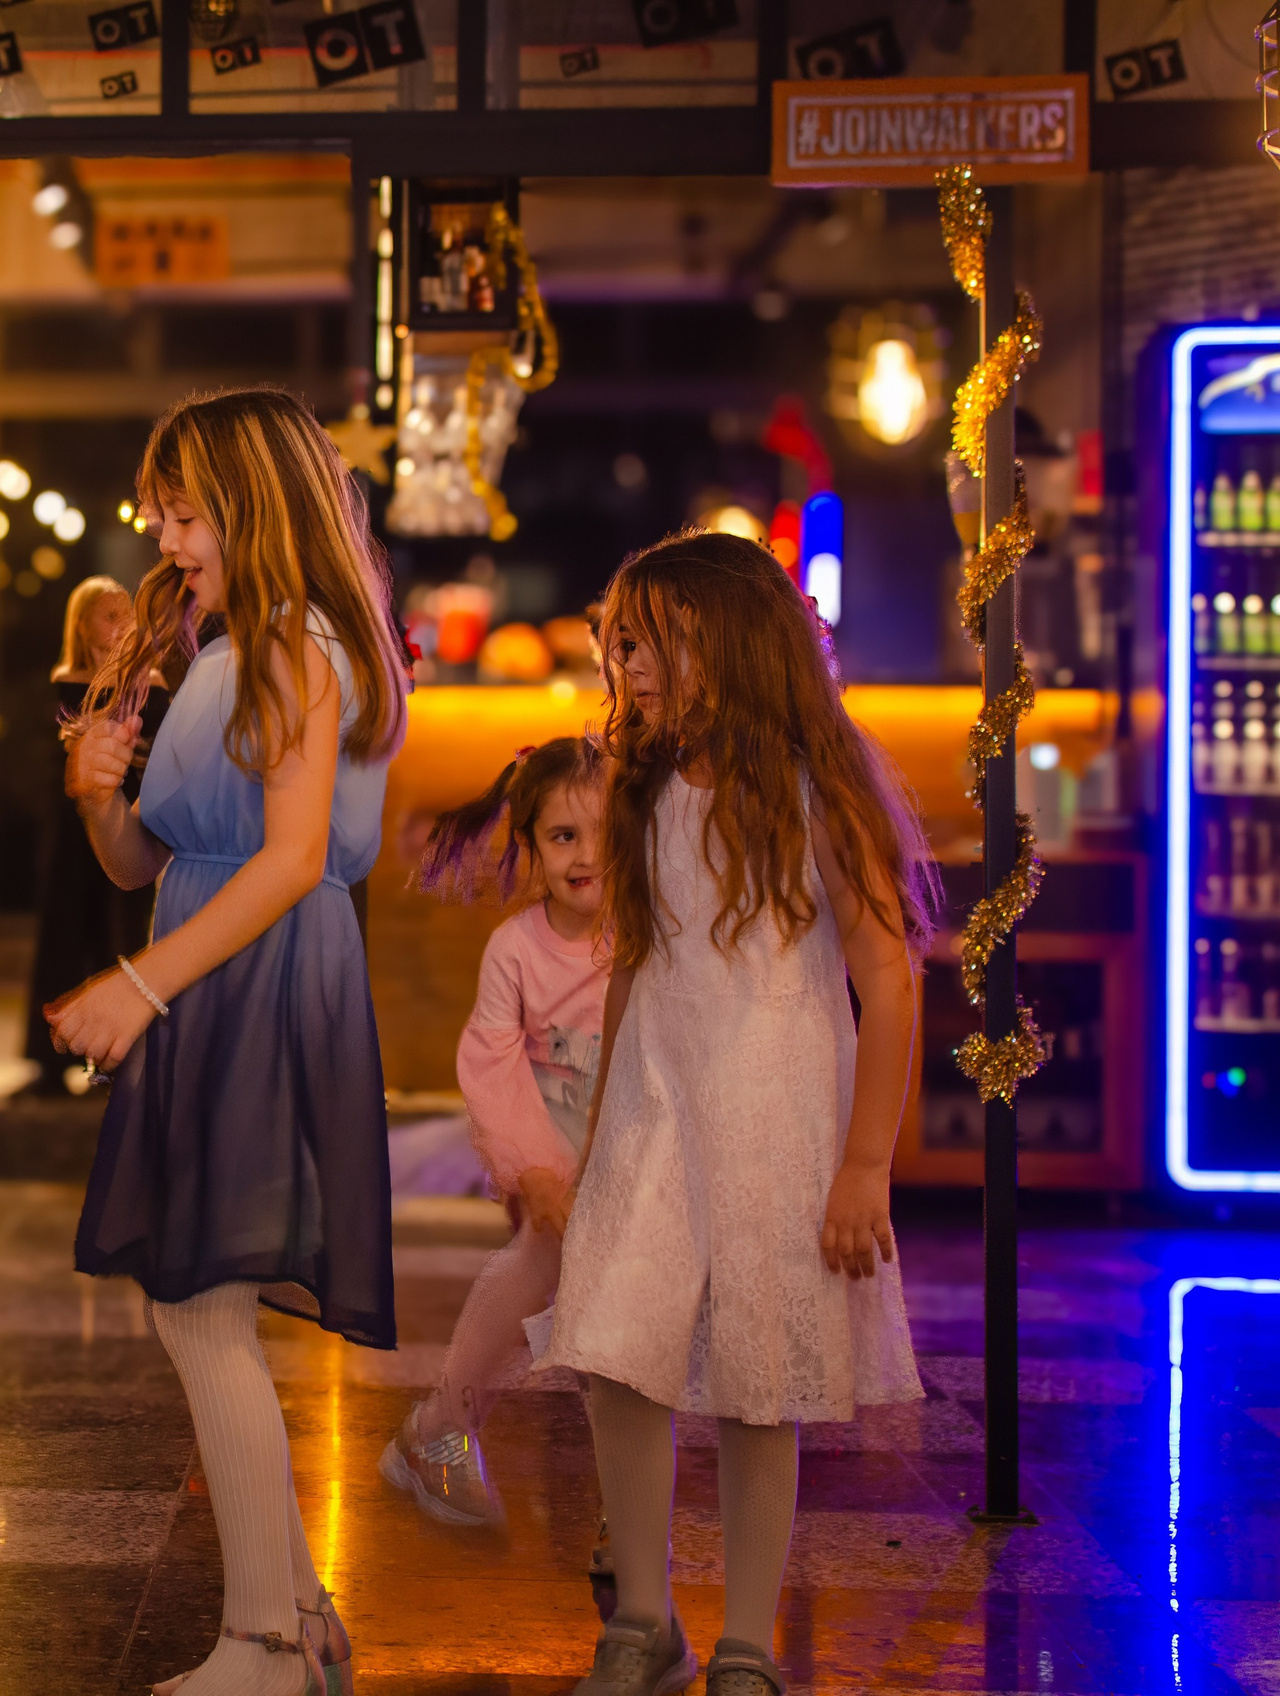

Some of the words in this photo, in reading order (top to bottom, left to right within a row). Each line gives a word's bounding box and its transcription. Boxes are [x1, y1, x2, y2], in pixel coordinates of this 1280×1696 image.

[95, 6, 149, 44] OT
[316, 8, 407, 72] OT
[102, 73, 136, 96] OT
[1112, 48, 1175, 88] OT
[798, 101, 1066, 156] #JOINWALKERS
